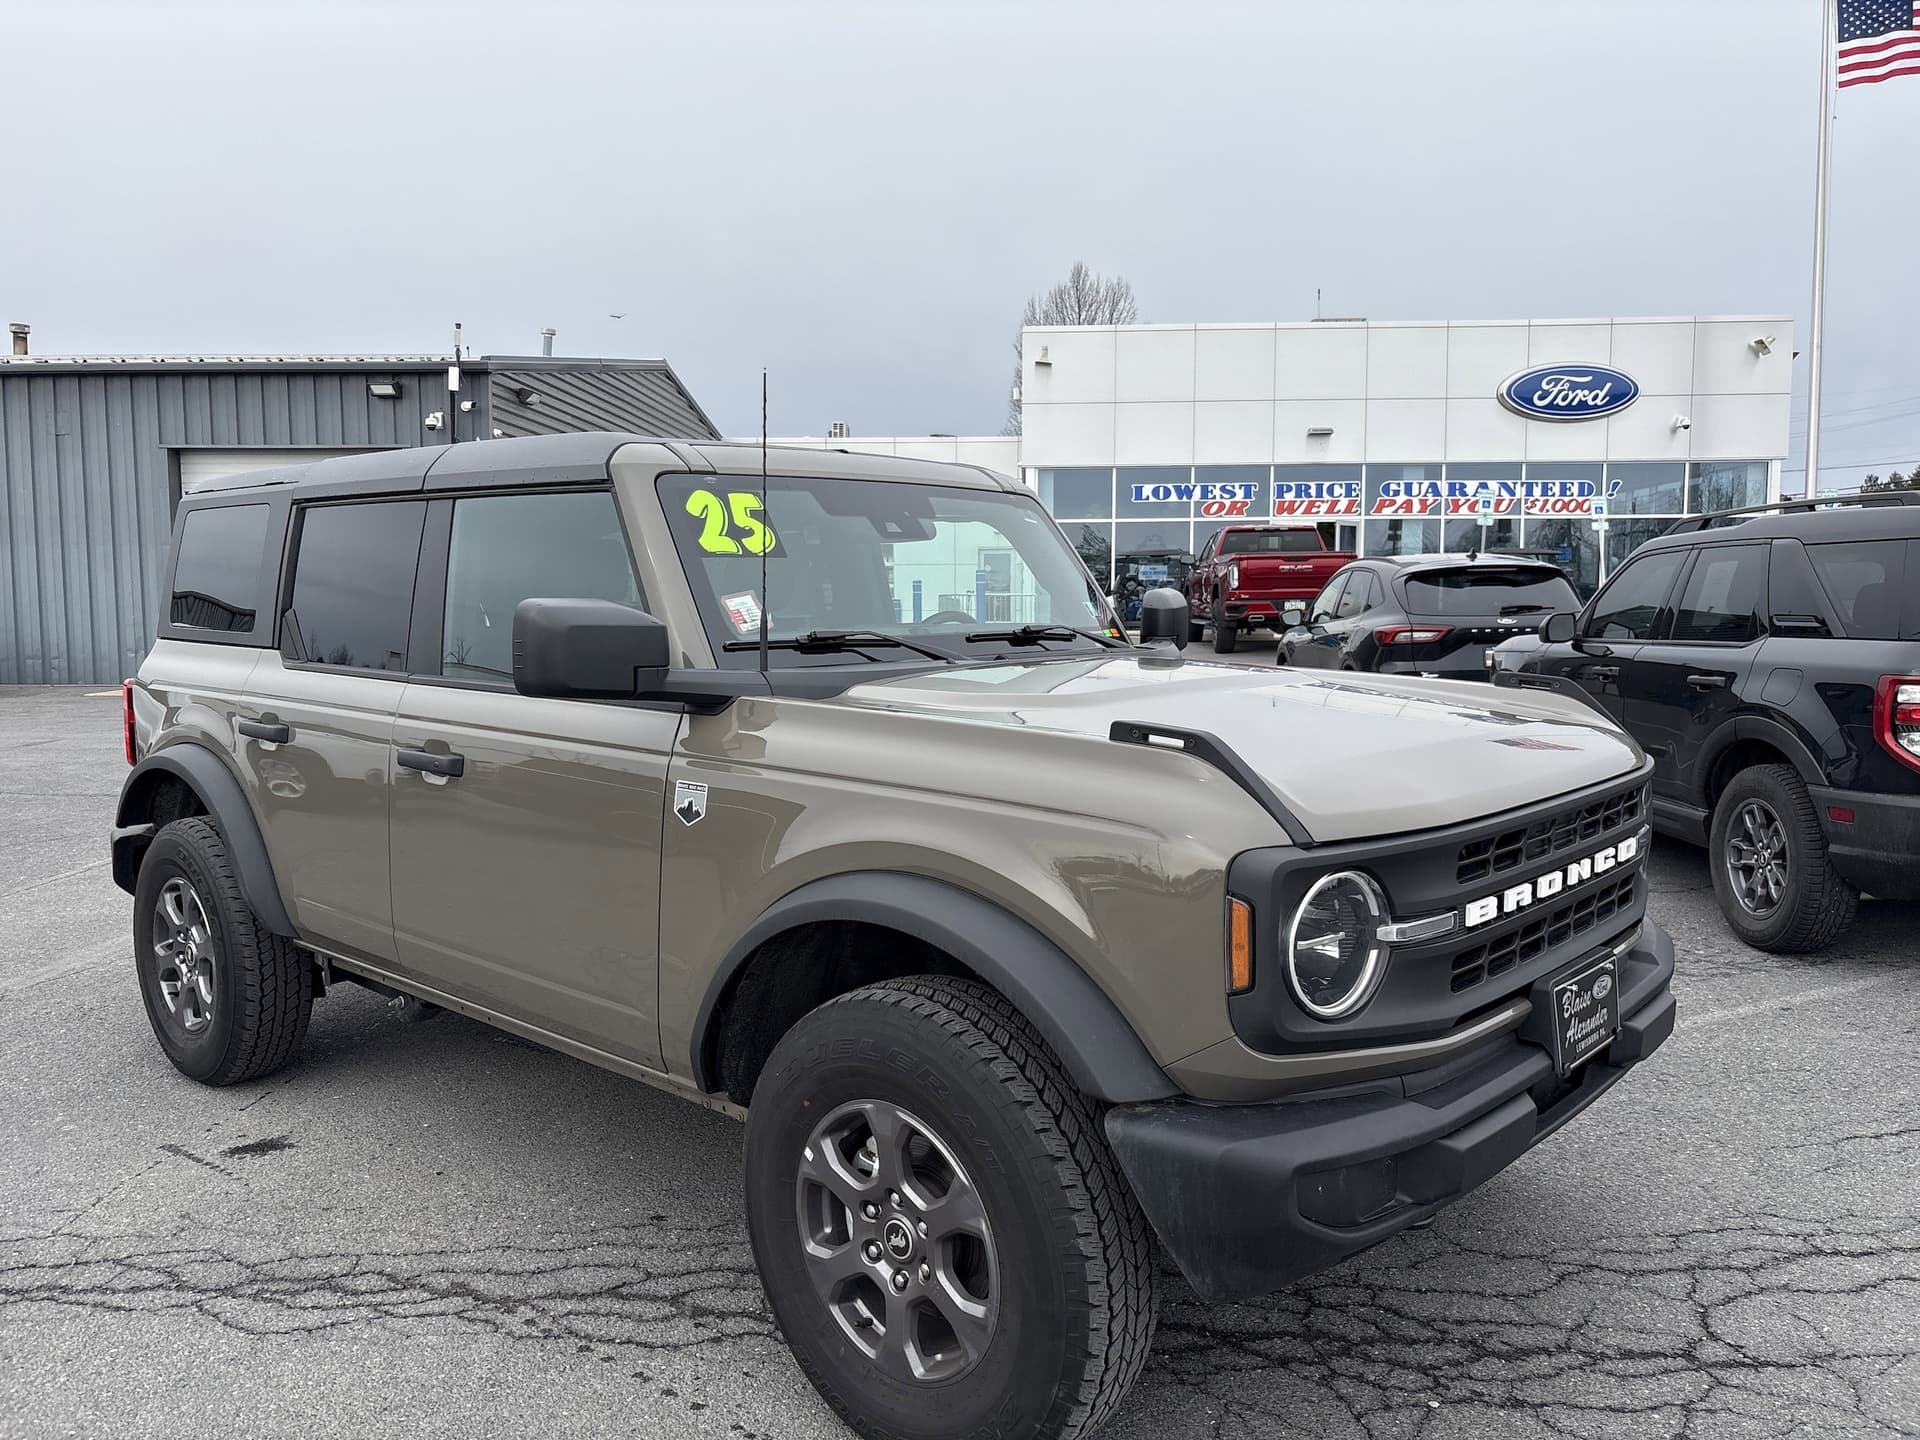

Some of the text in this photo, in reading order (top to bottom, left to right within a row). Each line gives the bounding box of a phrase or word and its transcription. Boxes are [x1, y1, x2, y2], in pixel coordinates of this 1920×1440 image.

[1533, 375, 1613, 407] Ford
[1132, 483, 1257, 501] LOWEST
[1275, 482, 1360, 499] PRICE
[1381, 481, 1594, 498] GUARANTEED
[1202, 500, 1249, 516] OR
[1372, 498, 1440, 514] PAY
[686, 490, 776, 556] 25
[1465, 837, 1637, 928] BRONCO
[1562, 990, 1592, 1019] Blaise
[1565, 1003, 1608, 1049] Alexander
